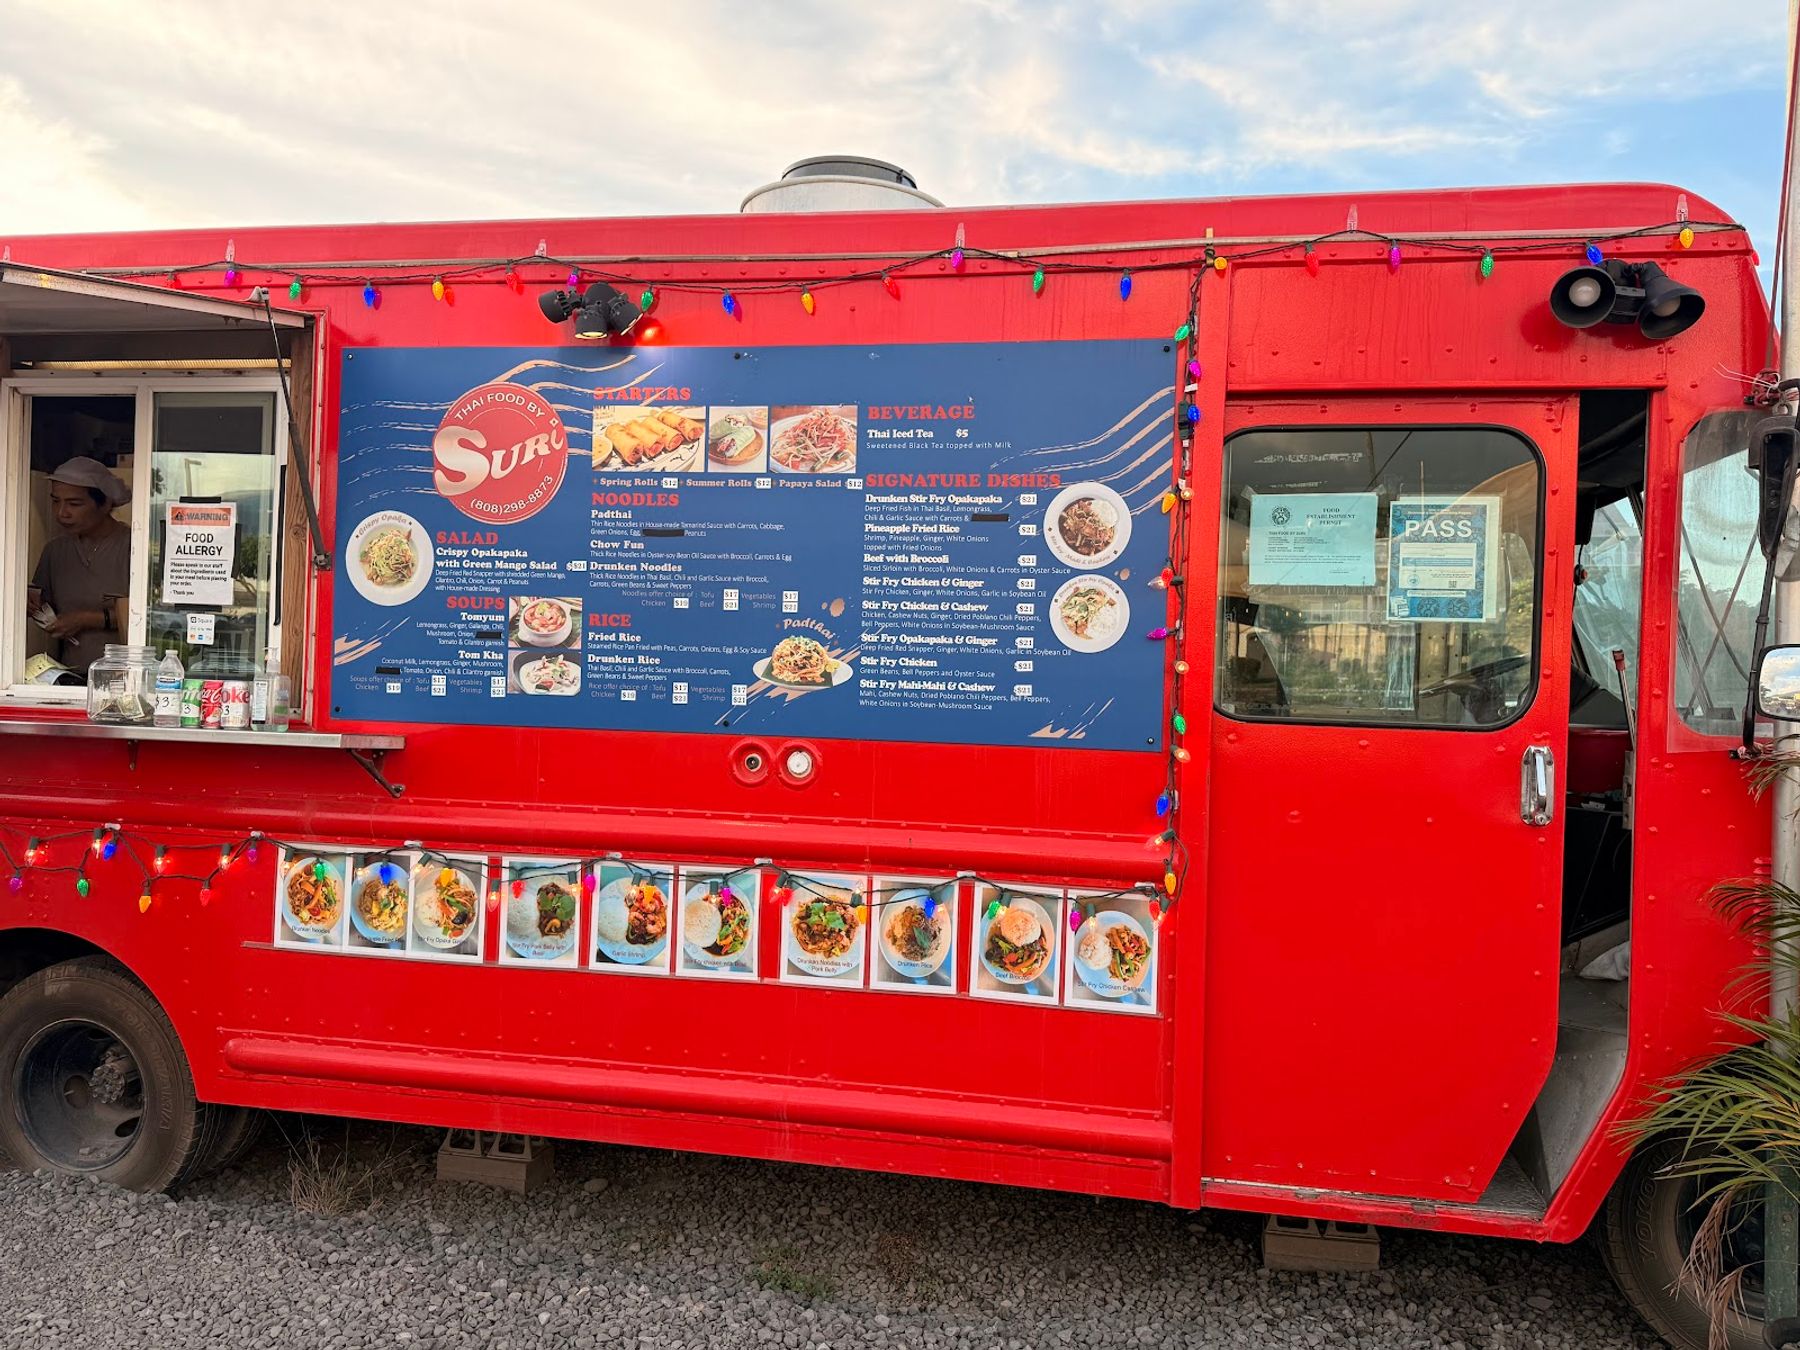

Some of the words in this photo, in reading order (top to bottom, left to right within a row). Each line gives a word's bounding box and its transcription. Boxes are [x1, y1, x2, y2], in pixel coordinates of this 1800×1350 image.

[593, 388, 691, 400] STARTERS
[454, 396, 484, 421] THAI
[488, 392, 526, 406] FOOD
[526, 402, 545, 418] BY
[868, 405, 975, 420] BEVERAGE
[867, 429, 890, 438] Thai
[892, 429, 913, 438] Iced
[915, 429, 933, 438] Tea
[956, 429, 968, 438] $5
[945, 442, 973, 450] topped
[600, 478, 632, 488] Spring
[779, 480, 813, 488] Papaya
[865, 474, 980, 487] SIGNATURE
[987, 474, 1061, 487] DISHES
[470, 475, 552, 516] (808)298-8873
[592, 493, 679, 507] NOODLES
[865, 494, 908, 503] Drunken
[909, 494, 927, 503] Stir
[928, 494, 946, 505] Fry
[947, 494, 1002, 505] Opakapaka
[187, 512, 228, 520] WARNING
[591, 509, 631, 519] Padthai
[864, 523, 910, 534] Pineapple
[911, 524, 937, 533] Fried
[938, 524, 959, 533] Rice
[1405, 520, 1472, 537] PASS
[185, 533, 214, 543] FOOD
[436, 531, 498, 545] SALAD
[590, 540, 620, 549] Chow
[623, 540, 644, 549] Fun
[864, 544, 886, 552] topped
[176, 546, 222, 555] ALLERGY
[436, 547, 468, 558] Crispy
[470, 548, 527, 559] Opakapaka
[863, 554, 884, 563] Beef
[885, 554, 908, 563] with
[910, 554, 948, 563] Broccoli
[436, 559, 460, 568] with
[462, 560, 492, 569] Green
[494, 560, 527, 571] Mango
[528, 561, 557, 570] Salad
[590, 562, 637, 571] Drunken
[639, 563, 682, 572] Noodles
[863, 576, 880, 585] Stir
[882, 577, 899, 587] Fry
[901, 577, 939, 586] Chicken
[940, 578, 950, 586] &
[951, 578, 983, 589] Ginger
[446, 596, 505, 609] SOUPS
[862, 600, 880, 609] Stir
[881, 600, 898, 611] Fry
[900, 601, 939, 610] Chicken
[940, 601, 950, 610] &
[950, 602, 988, 611] Cashew
[460, 612, 505, 623] Tomyum
[589, 614, 631, 627] RICE
[588, 632, 615, 642] Fried
[618, 633, 640, 642] Rice
[861, 633, 879, 642] Stir
[880, 633, 897, 644] Fry
[899, 633, 952, 645] Opakapaka
[954, 634, 963, 643] &
[965, 635, 997, 646] Ginger
[483, 651, 503, 660] Kha
[588, 654, 634, 664] Drunken
[637, 655, 660, 664] Rice
[860, 656, 878, 665] Stir
[880, 657, 896, 668] Fry
[898, 657, 937, 667] Chicken
[914, 669, 939, 678] Peppers
[953, 670, 974, 679] Oyster
[860, 679, 877, 688] Stir
[879, 680, 896, 691] Fry
[897, 680, 945, 690] Mahi-Mahi
[947, 681, 956, 690] &
[957, 682, 994, 692] Cashew
[909, 701, 971, 711] Soybean-Mushroom
